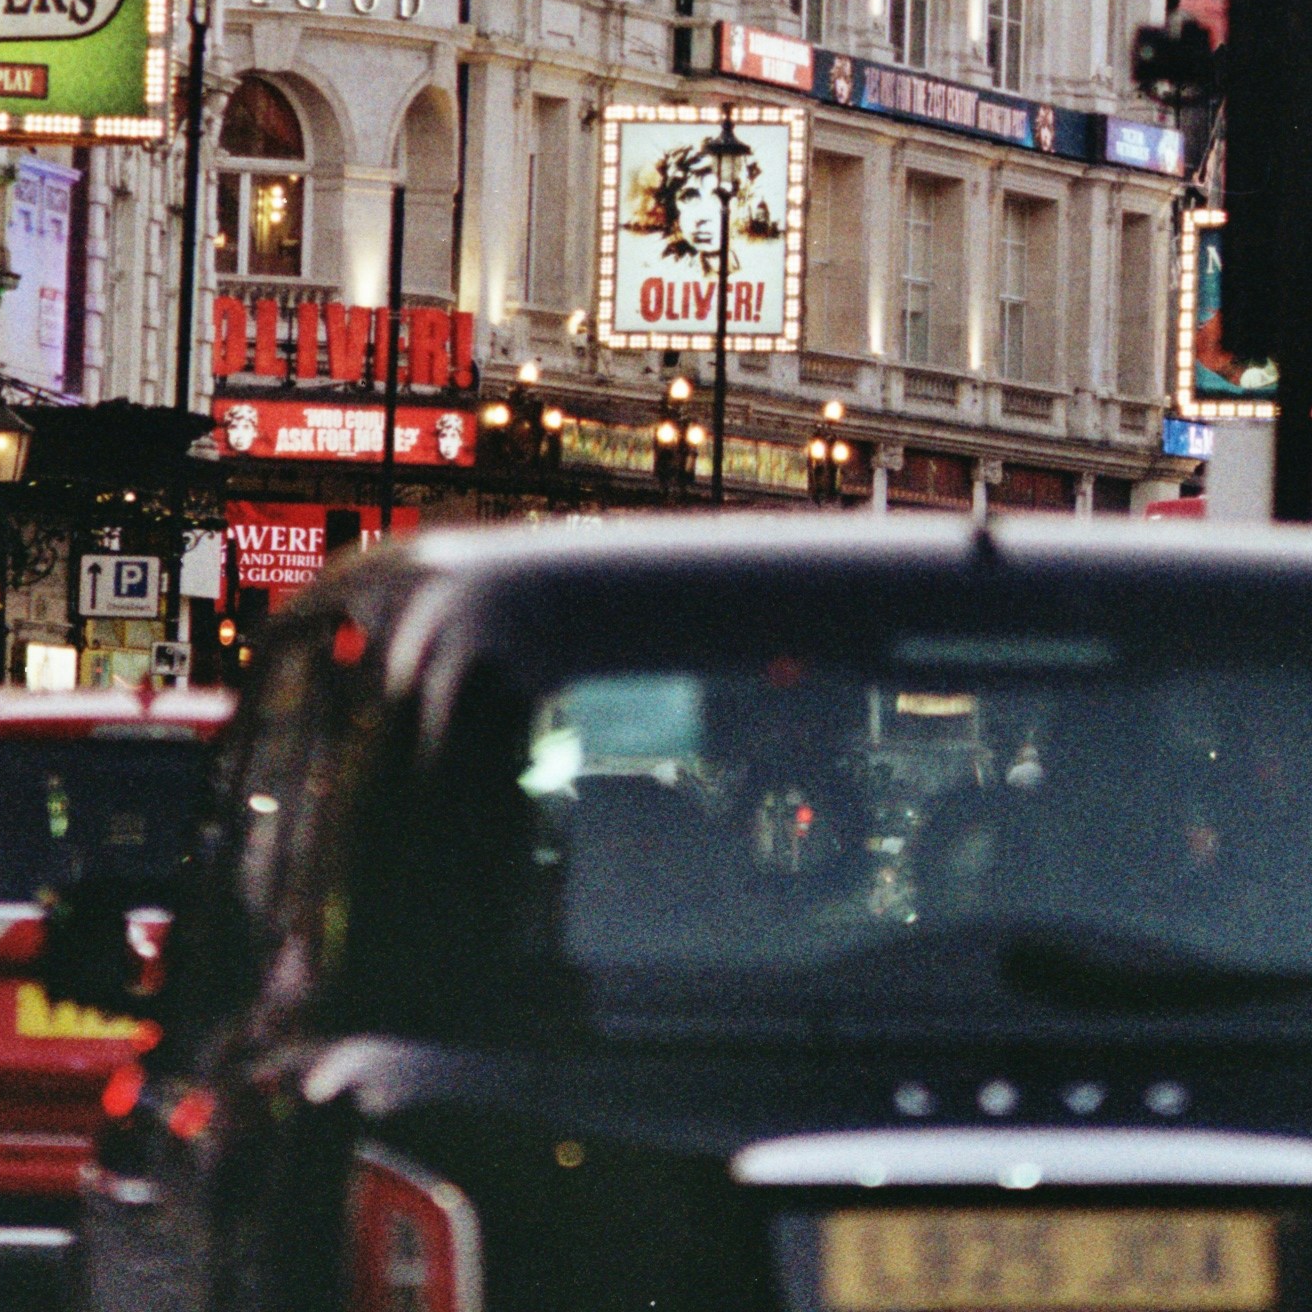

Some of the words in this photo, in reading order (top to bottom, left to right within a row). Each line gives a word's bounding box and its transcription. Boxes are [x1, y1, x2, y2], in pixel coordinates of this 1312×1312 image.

[345, 410, 385, 429] COUL
[275, 428, 315, 452] ASK
[316, 428, 352, 452] FOR
[240, 552, 274, 565] AND
[121, 565, 143, 594] P
